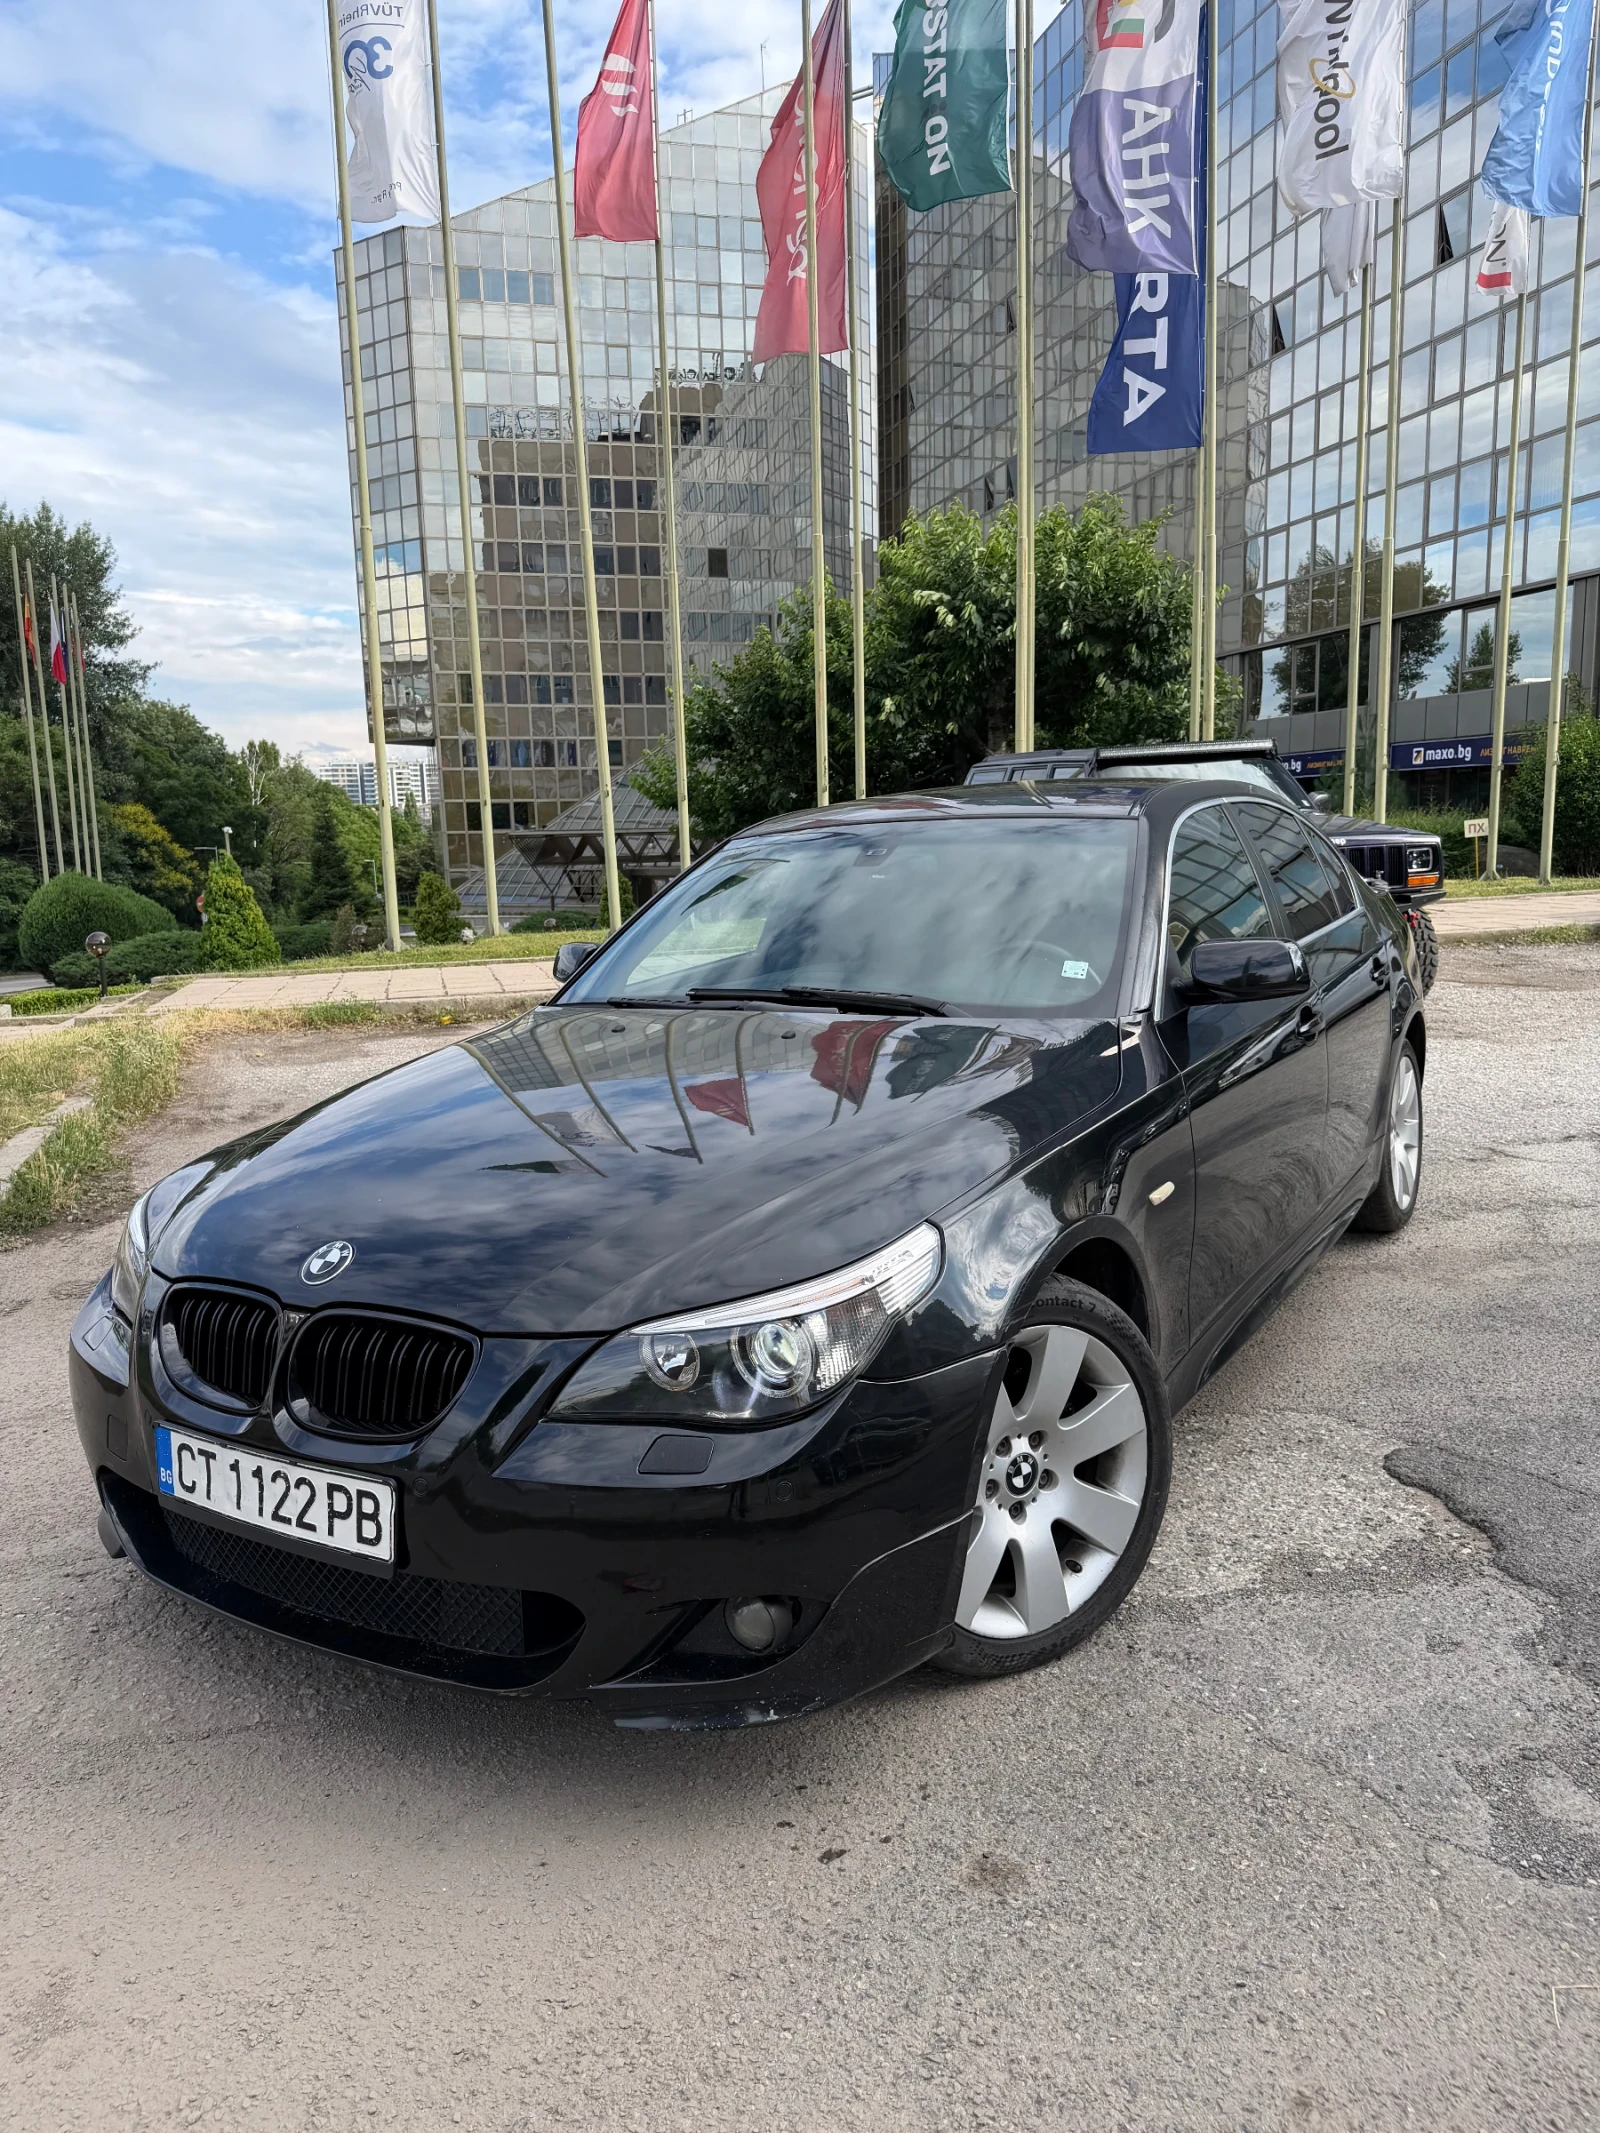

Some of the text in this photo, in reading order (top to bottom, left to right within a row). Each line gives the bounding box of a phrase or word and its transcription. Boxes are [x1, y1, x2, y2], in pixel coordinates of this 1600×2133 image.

[1121, 98, 1172, 239] AHK
[1425, 744, 1472, 762] maxo.bg
[1480, 746, 1507, 757] ЛИЗГ
[1468, 822, 1485, 834] ПХ
[1031, 1295, 1097, 1313] ontact 7
[159, 1466, 173, 1485] BG
